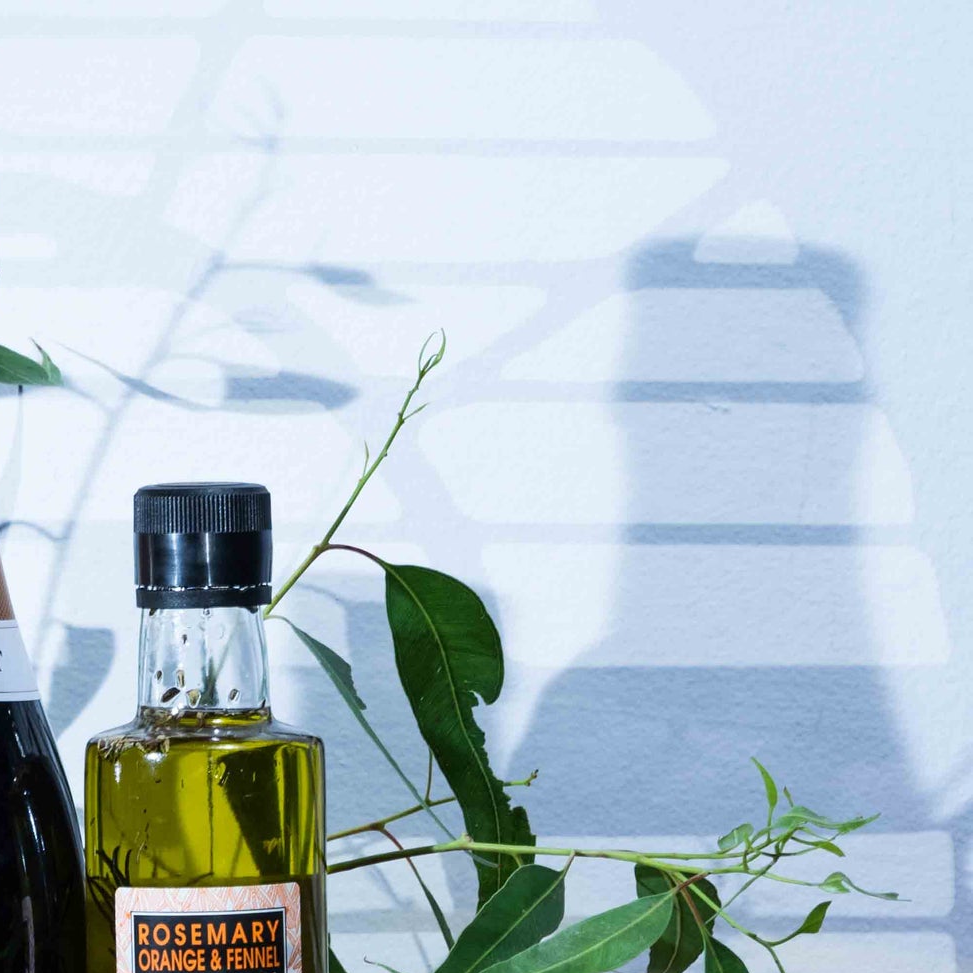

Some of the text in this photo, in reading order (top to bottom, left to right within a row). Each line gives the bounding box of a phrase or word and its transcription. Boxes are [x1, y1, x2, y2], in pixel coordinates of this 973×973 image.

[137, 919, 280, 946] ROSEMARY
[138, 945, 280, 972] ORANGE & FENNEL
